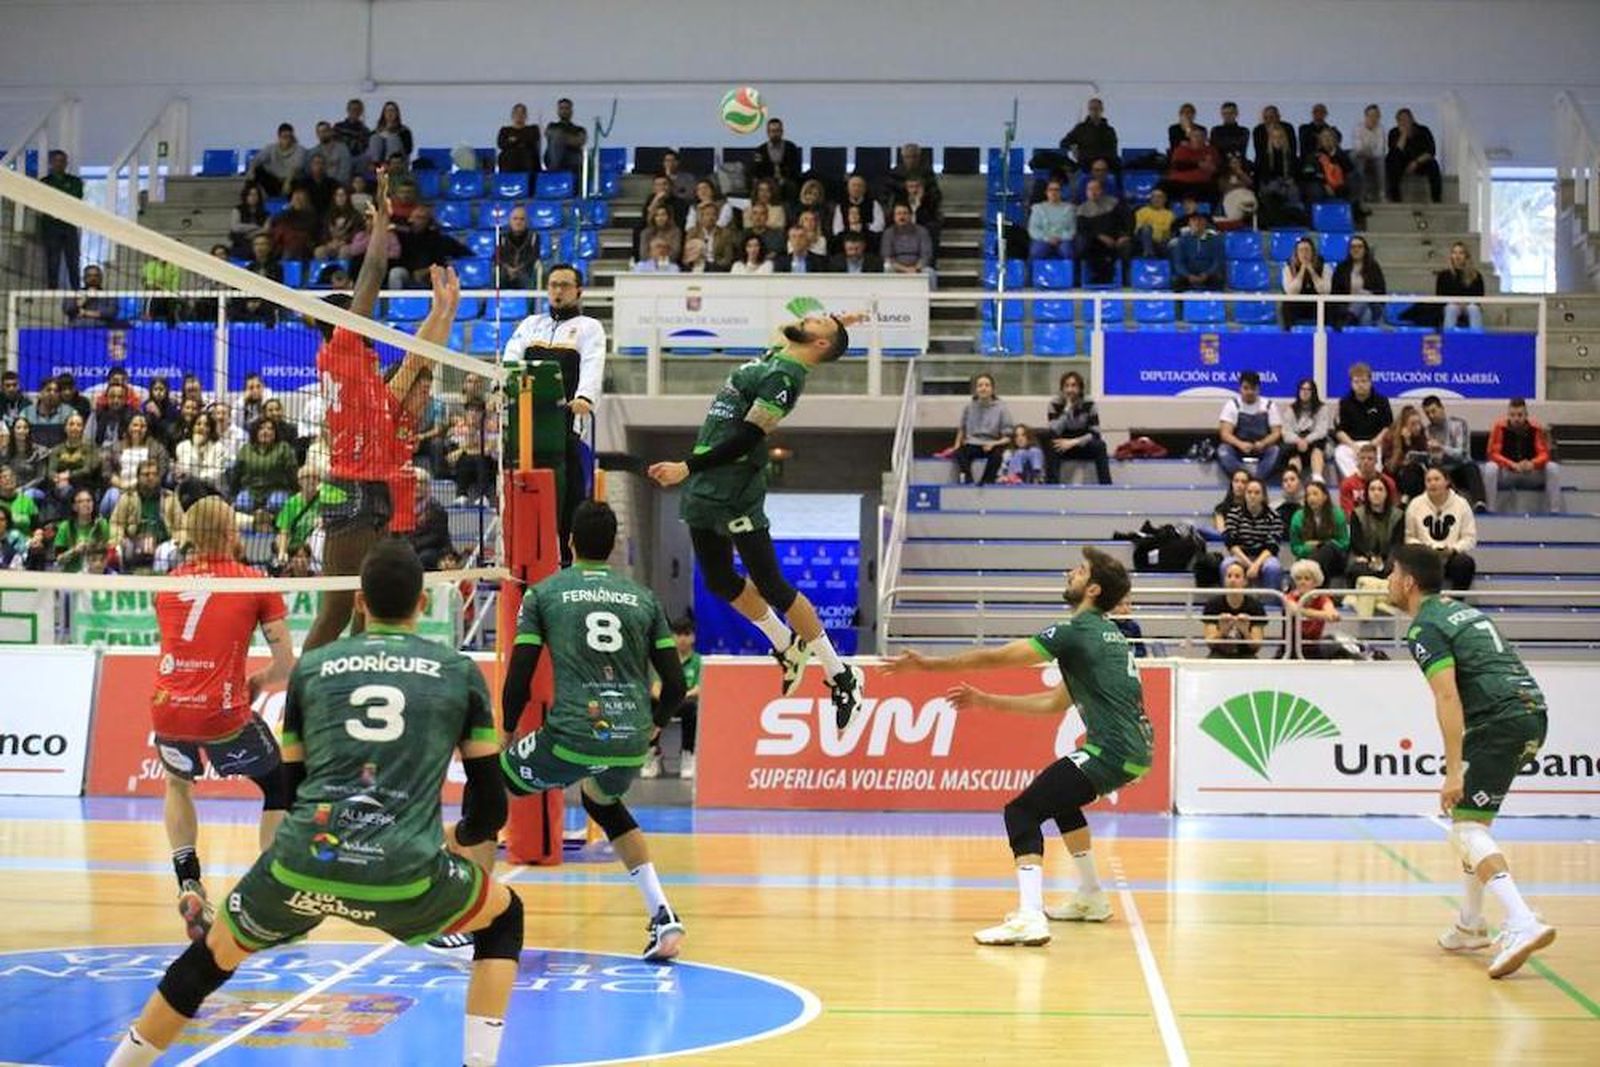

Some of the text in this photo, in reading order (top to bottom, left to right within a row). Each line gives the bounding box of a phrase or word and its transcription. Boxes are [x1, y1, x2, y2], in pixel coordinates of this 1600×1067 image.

[1140, 367, 1207, 383] DIPUTACIÓN
[1211, 370, 1228, 383] DE
[1369, 369, 1501, 385] IPUTACIÓN DE ALMERÍA
[562, 587, 640, 607] FERNÁNDEZ
[177, 590, 213, 642] 7
[585, 611, 624, 653] 8
[1473, 620, 1504, 654] 7
[320, 651, 442, 678] RODRÍGUEZ
[344, 684, 406, 743] 3
[755, 698, 958, 758] SVM
[0, 732, 68, 756] nco
[748, 768, 1042, 792] SUPERLIGA VOLEIBOL MASCULIN
